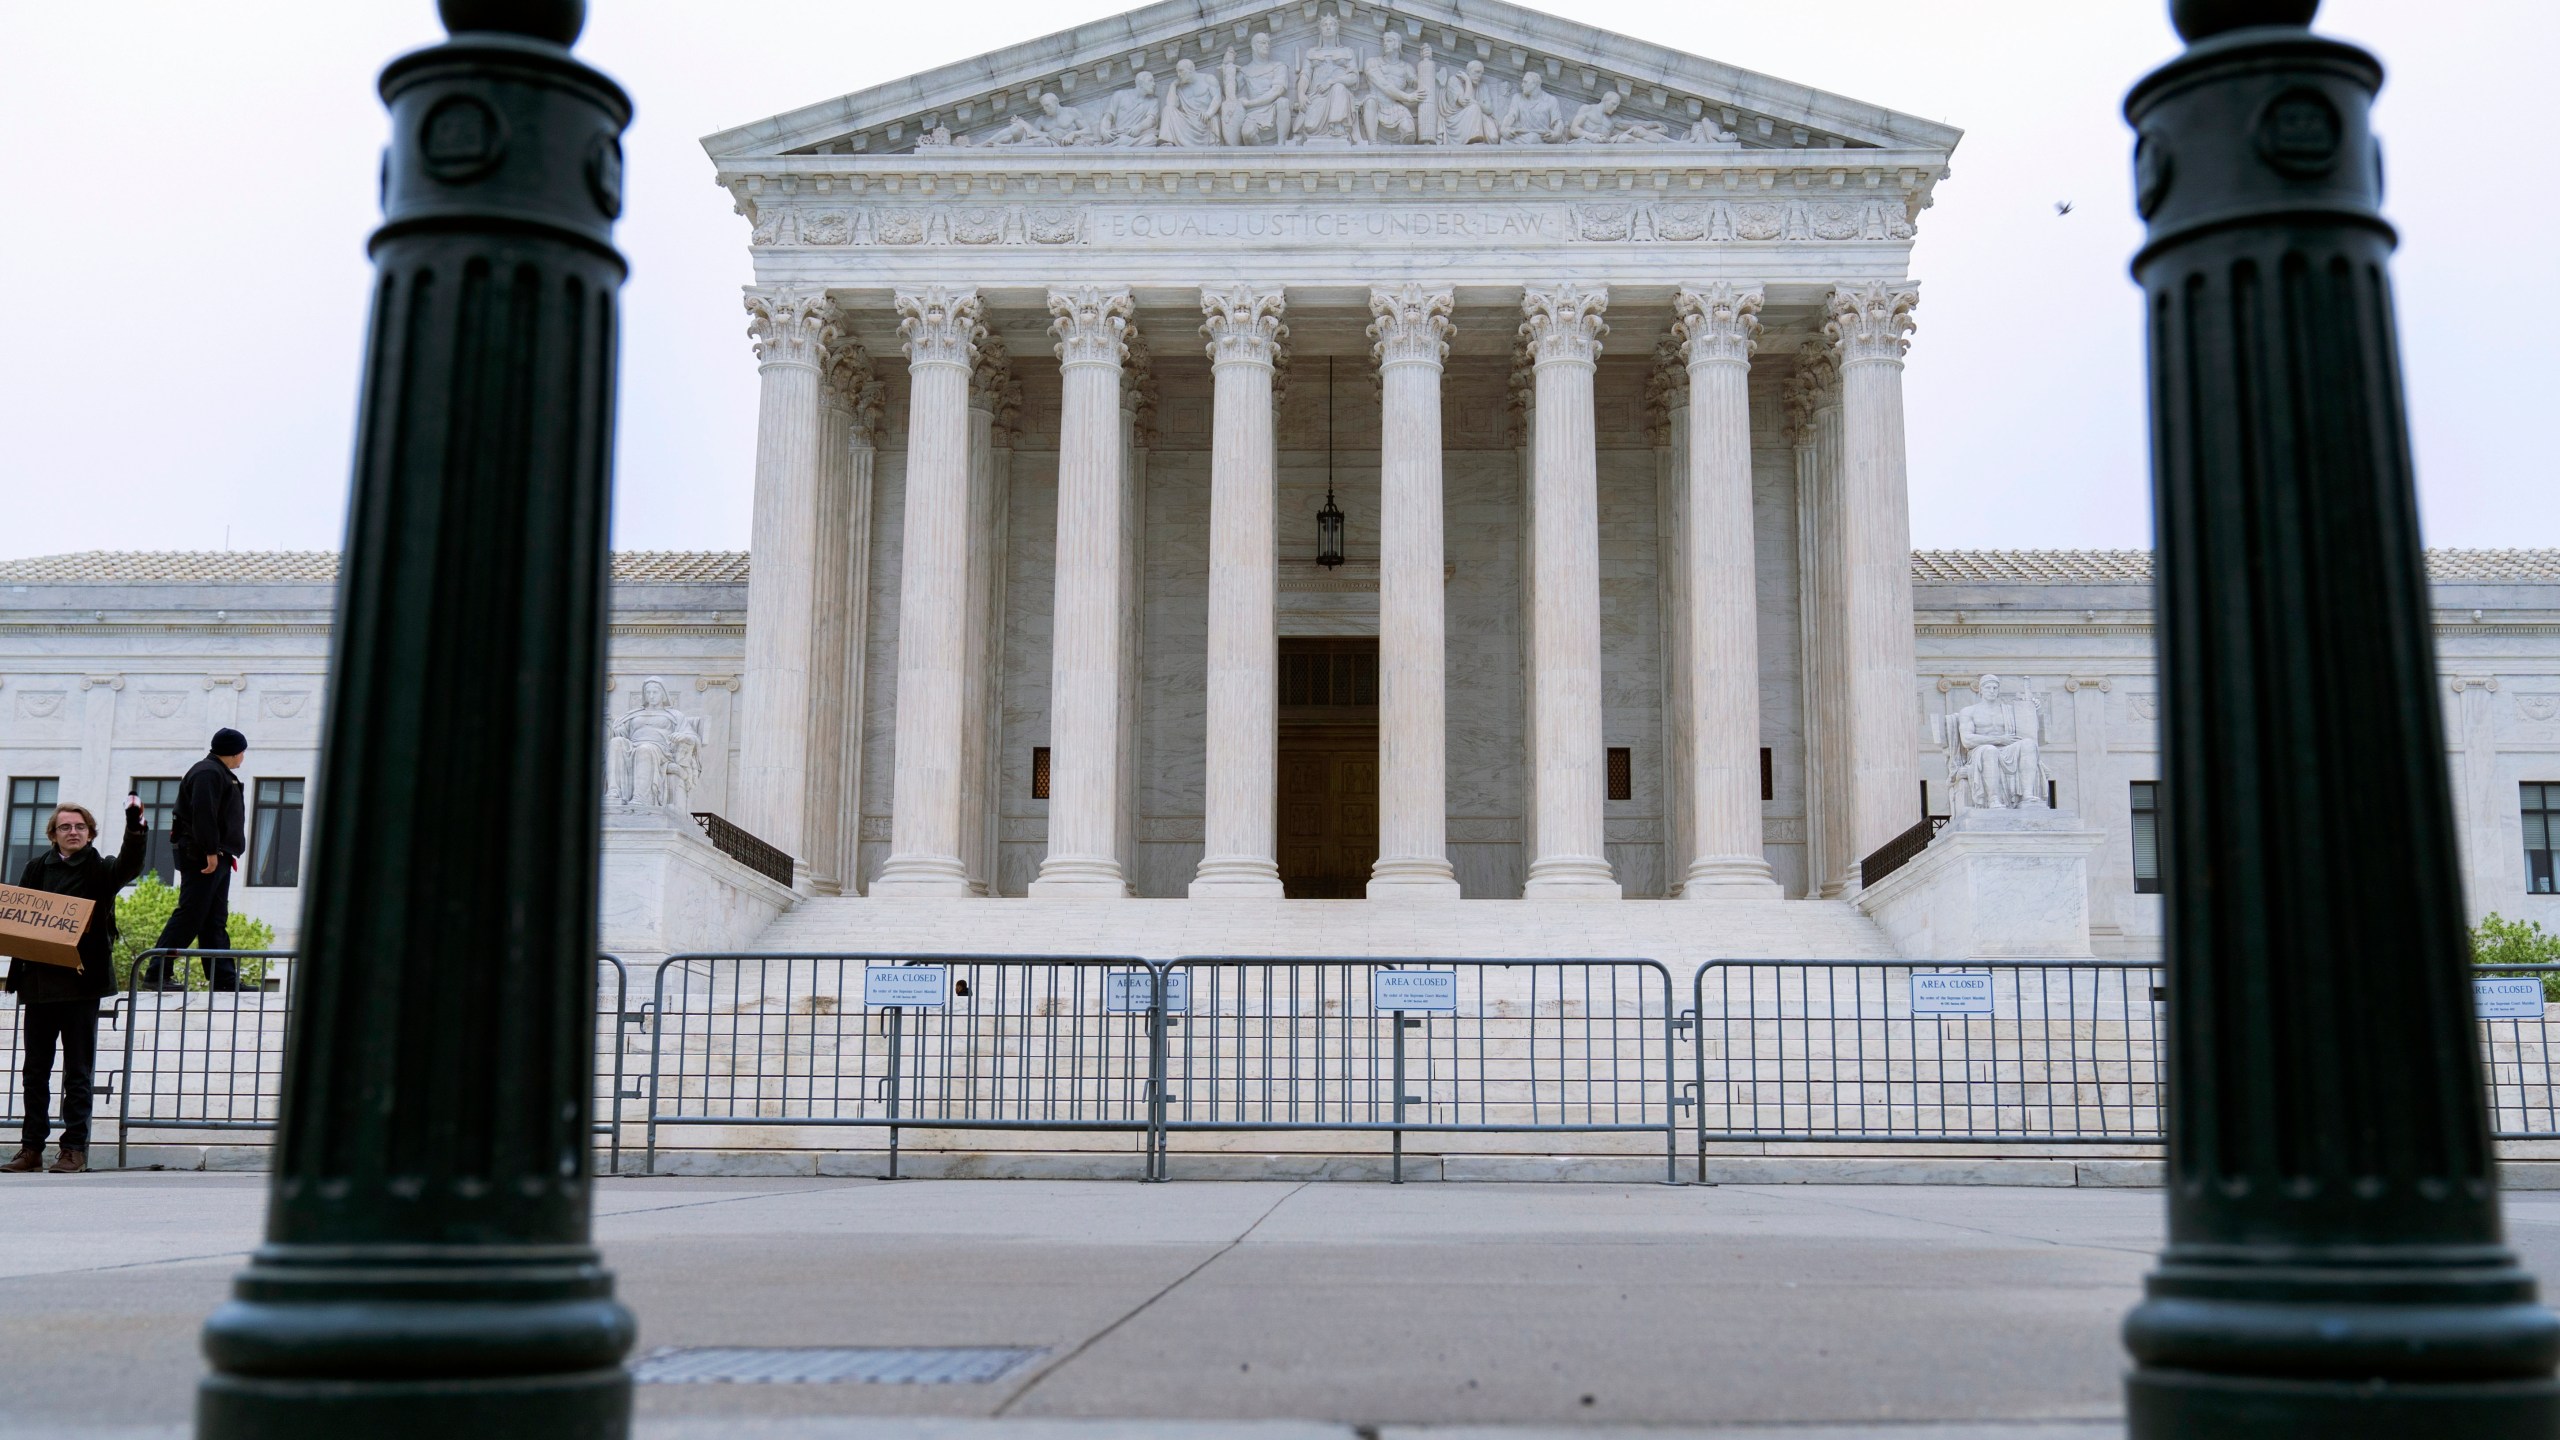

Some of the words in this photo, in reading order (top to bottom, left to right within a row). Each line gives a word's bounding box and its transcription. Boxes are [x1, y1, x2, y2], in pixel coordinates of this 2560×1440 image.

[1111, 214, 1218, 238] EQUAL
[1225, 213, 1350, 236] JUSTICE
[1365, 213, 1478, 236] UNDER
[1483, 212, 1545, 236] LAW
[0, 890, 54, 912] BORTION
[62, 902, 79, 917] IS
[875, 973, 899, 982] AREA
[902, 974, 937, 982] CLOSED
[1384, 977, 1410, 986] AREA
[1413, 978, 1448, 987] CLOSED
[1145, 979, 1179, 987] CED
[1921, 980, 1946, 989] AREA
[1949, 980, 1984, 989] CLOSED
[2497, 986, 2533, 994] CLOSED
